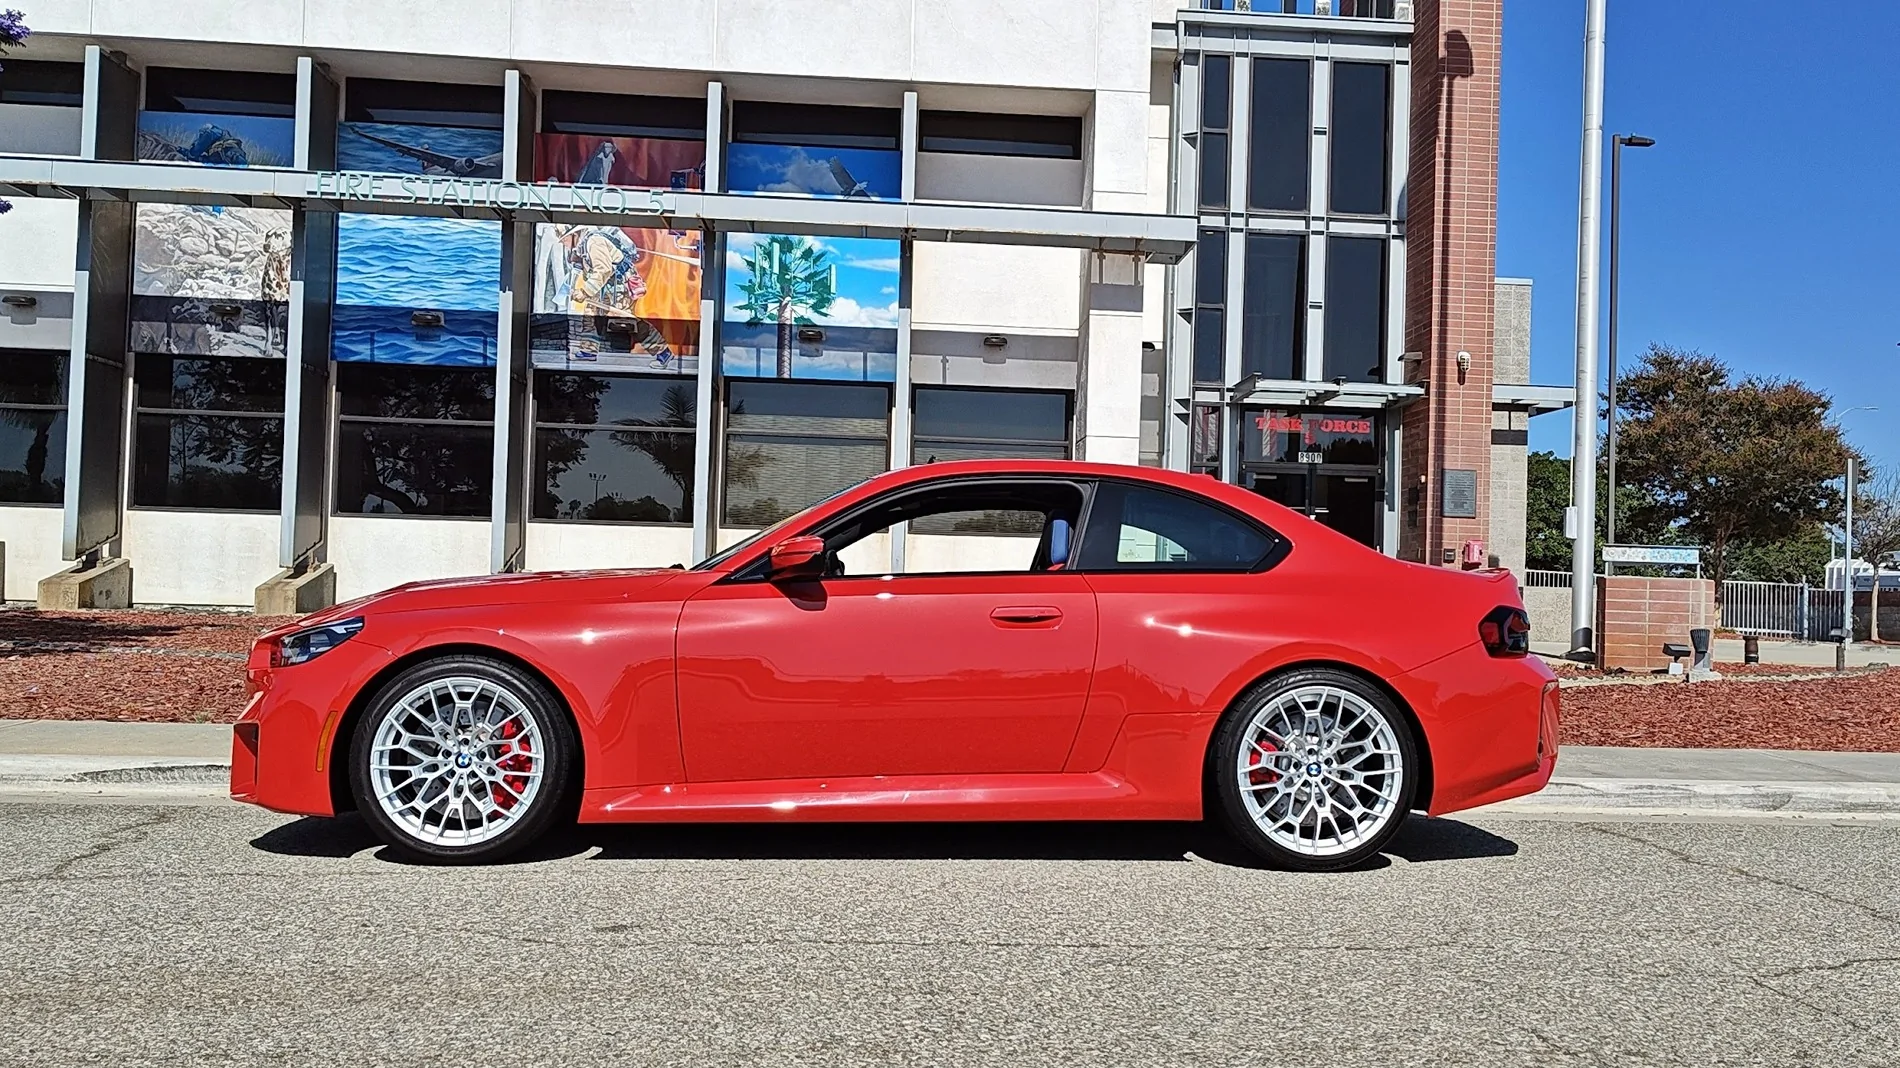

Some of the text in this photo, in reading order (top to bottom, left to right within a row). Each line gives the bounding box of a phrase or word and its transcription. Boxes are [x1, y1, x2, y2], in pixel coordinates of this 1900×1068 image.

[317, 171, 664, 216] FIRE STATION NO. 5
[1255, 417, 1371, 433] TASK FORCE
[1298, 452, 1322, 463] 8900
